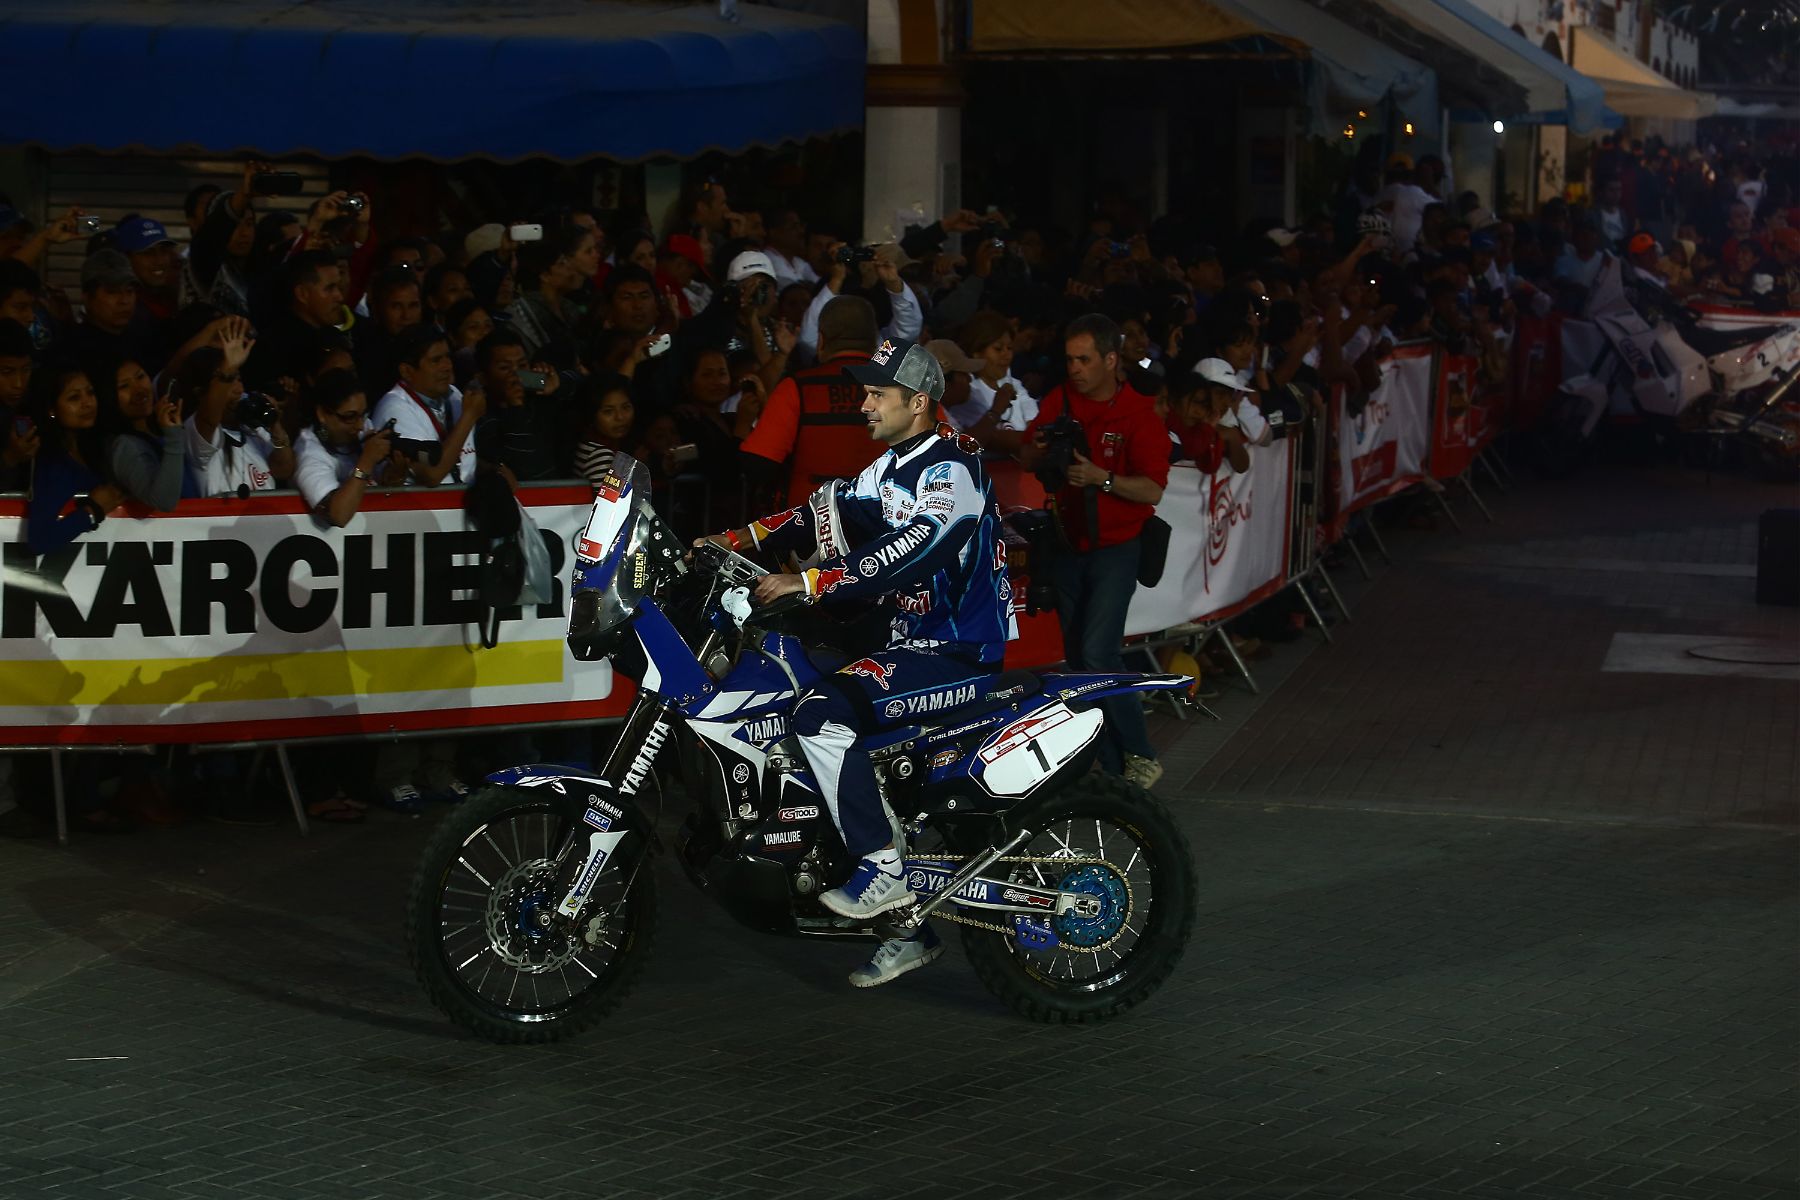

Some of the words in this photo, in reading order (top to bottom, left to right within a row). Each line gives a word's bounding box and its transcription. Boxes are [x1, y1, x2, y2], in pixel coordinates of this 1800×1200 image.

[874, 523, 932, 567] YAMAHA
[633, 552, 645, 589] SECDEM
[907, 684, 976, 713] YAMAHA
[619, 720, 672, 796] YAMAHA
[1026, 739, 1051, 772] 1
[588, 811, 610, 826] SKF
[596, 798, 623, 819] YAMAHA
[794, 807, 817, 819] TOOLS
[763, 830, 802, 846] YAMALUBE
[579, 850, 605, 894] MICHELIN
[928, 873, 988, 901] YAAHA
